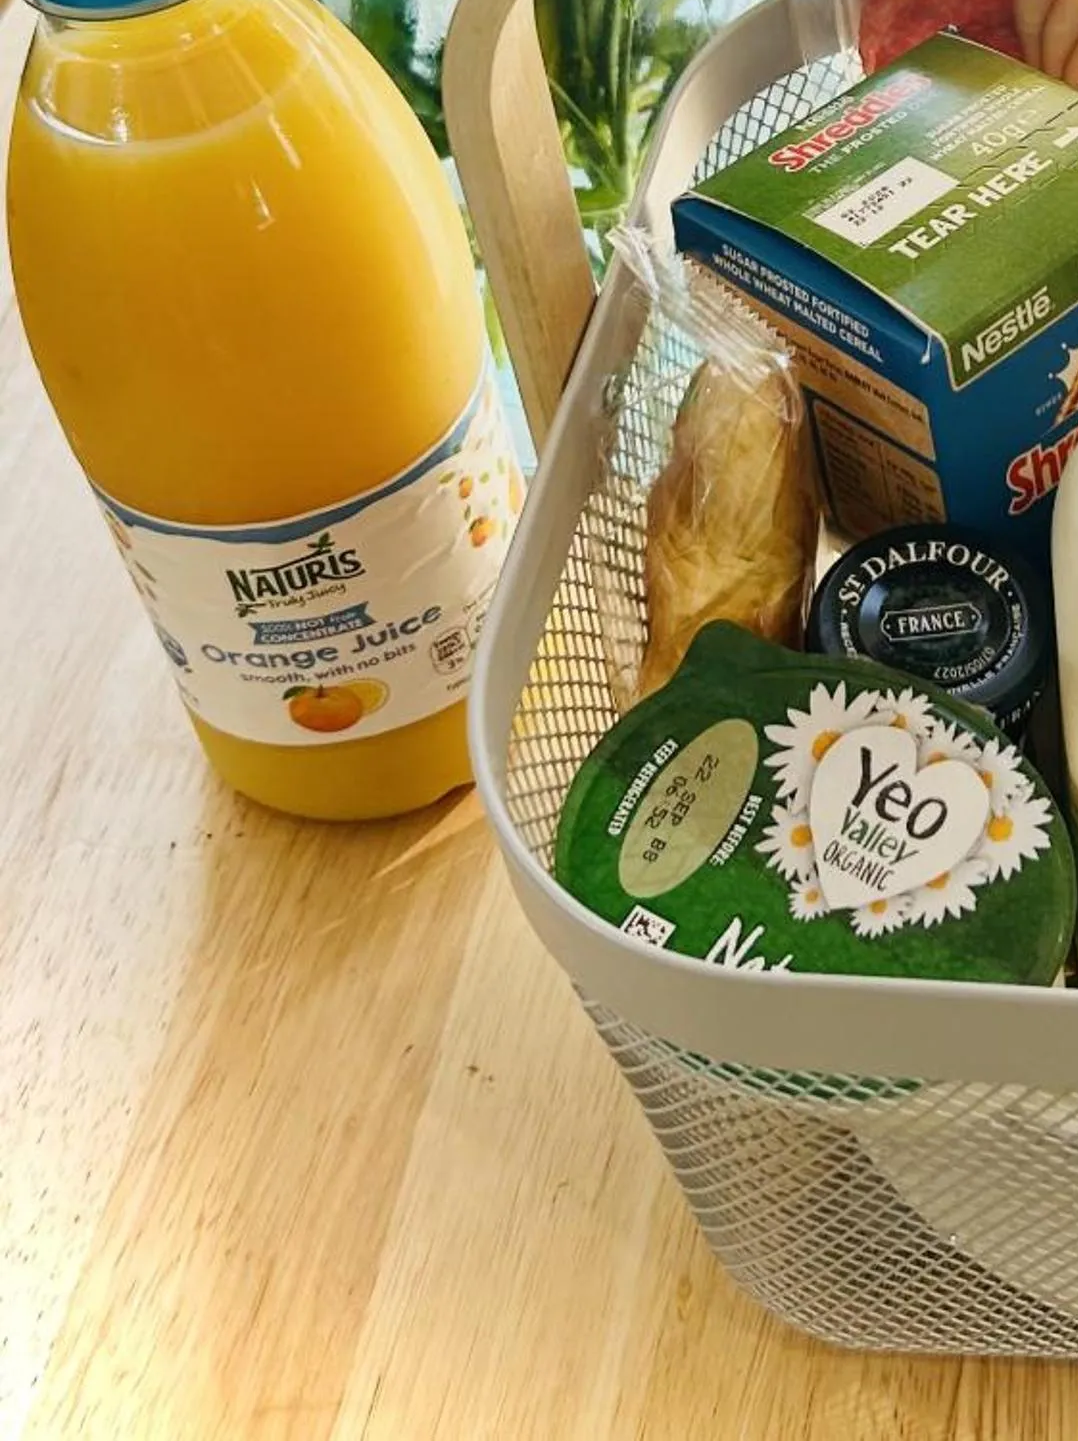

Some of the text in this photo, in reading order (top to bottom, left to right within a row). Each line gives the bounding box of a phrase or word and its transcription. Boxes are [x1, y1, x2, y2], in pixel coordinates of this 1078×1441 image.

[889, 203, 978, 259] TEAR
[967, 150, 1053, 208] HERE
[722, 244, 869, 339] SUGAR FROSTED FORTIFIED
[753, 277, 792, 312] WHEAT
[838, 327, 884, 363] CEREAL
[961, 286, 1052, 372] Nestlé
[226, 548, 367, 602] NATURIS
[838, 541, 1012, 607] ST DALFOUR
[200, 642, 340, 669] Orange
[351, 604, 443, 654] Juice
[898, 610, 966, 635] FRANCE
[314, 662, 355, 682] with
[356, 655, 381, 672] no
[383, 642, 417, 662] bits
[653, 738, 680, 767] KEEP
[694, 753, 721, 783] 22
[670, 789, 697, 827] SEP
[739, 794, 763, 826] BEST
[851, 746, 948, 839] Yeo
[839, 805, 922, 866] Valley
[822, 839, 895, 893] ORGANIC
